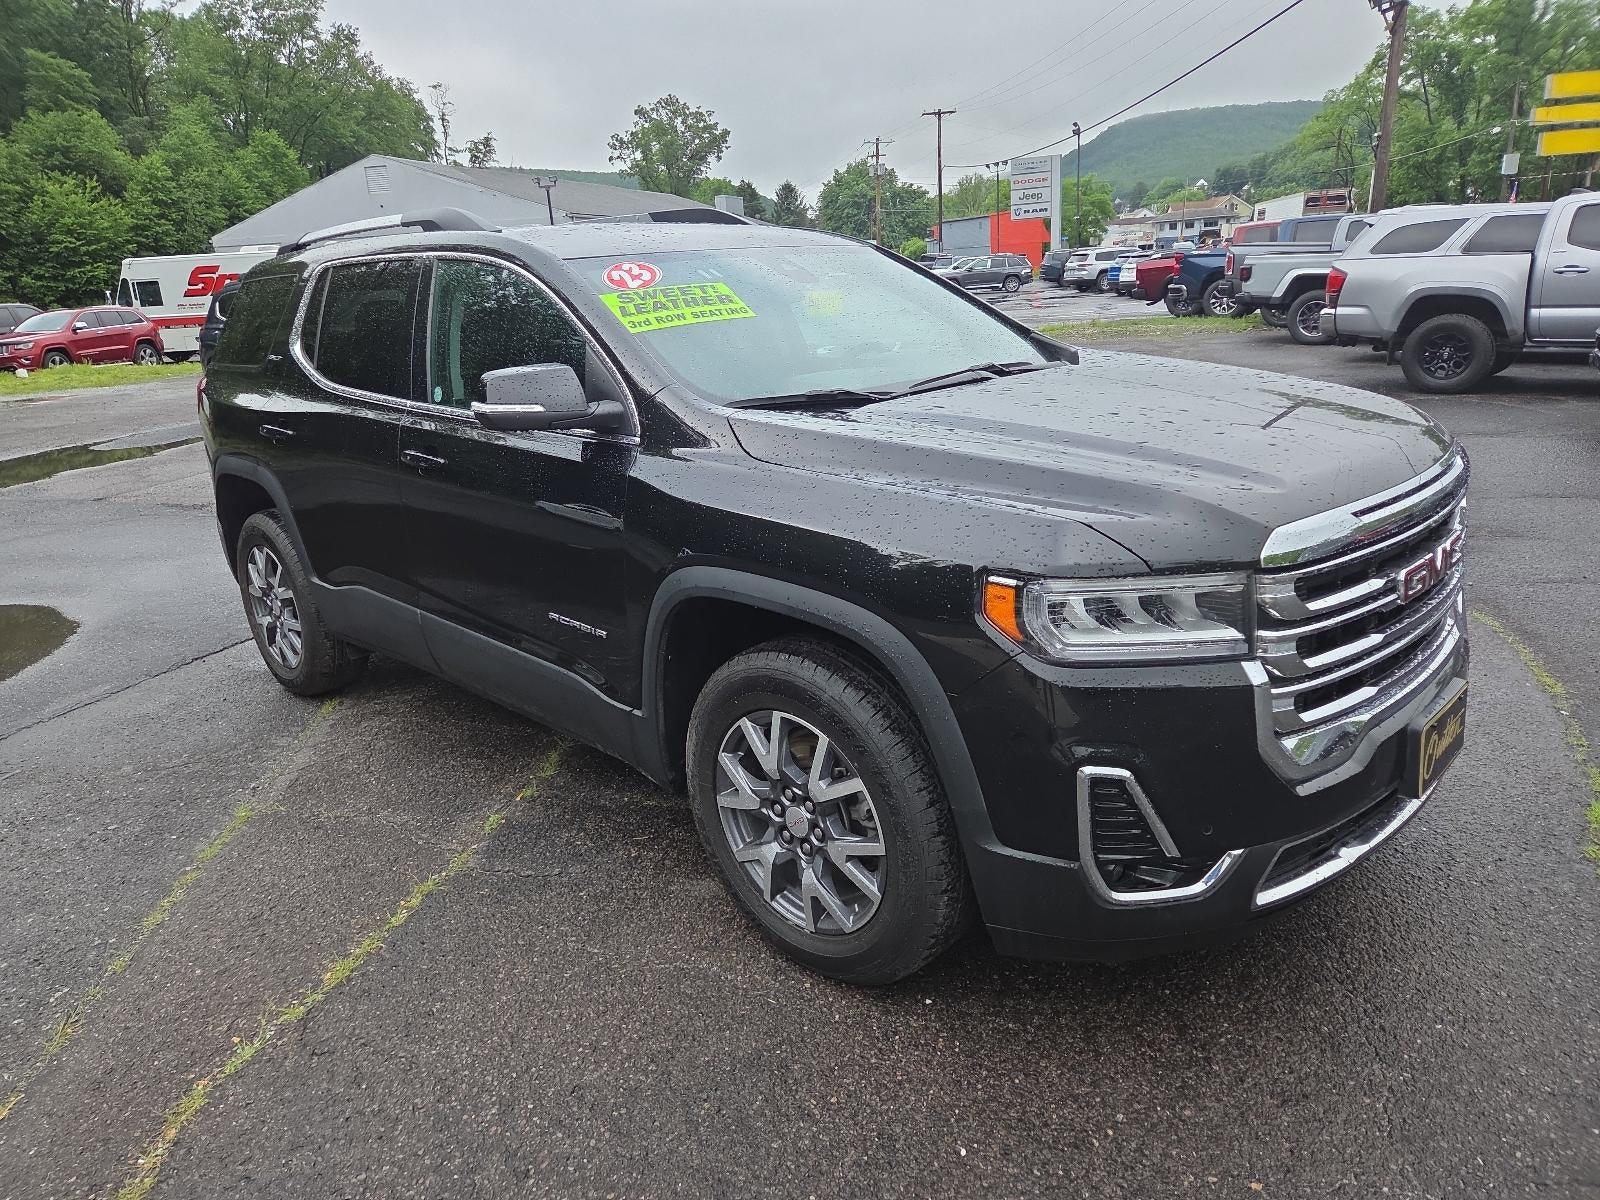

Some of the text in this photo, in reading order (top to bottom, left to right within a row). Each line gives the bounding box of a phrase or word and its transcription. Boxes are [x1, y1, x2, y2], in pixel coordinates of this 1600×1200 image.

[1013, 177, 1049, 185] DODGE
[1018, 191, 1043, 201] Jeep
[611, 261, 652, 289] 23
[616, 284, 719, 304] SWEET!
[618, 294, 735, 317] LEATHER
[628, 306, 750, 330] 3rd ROW SEATING
[1400, 529, 1464, 605] GMC
